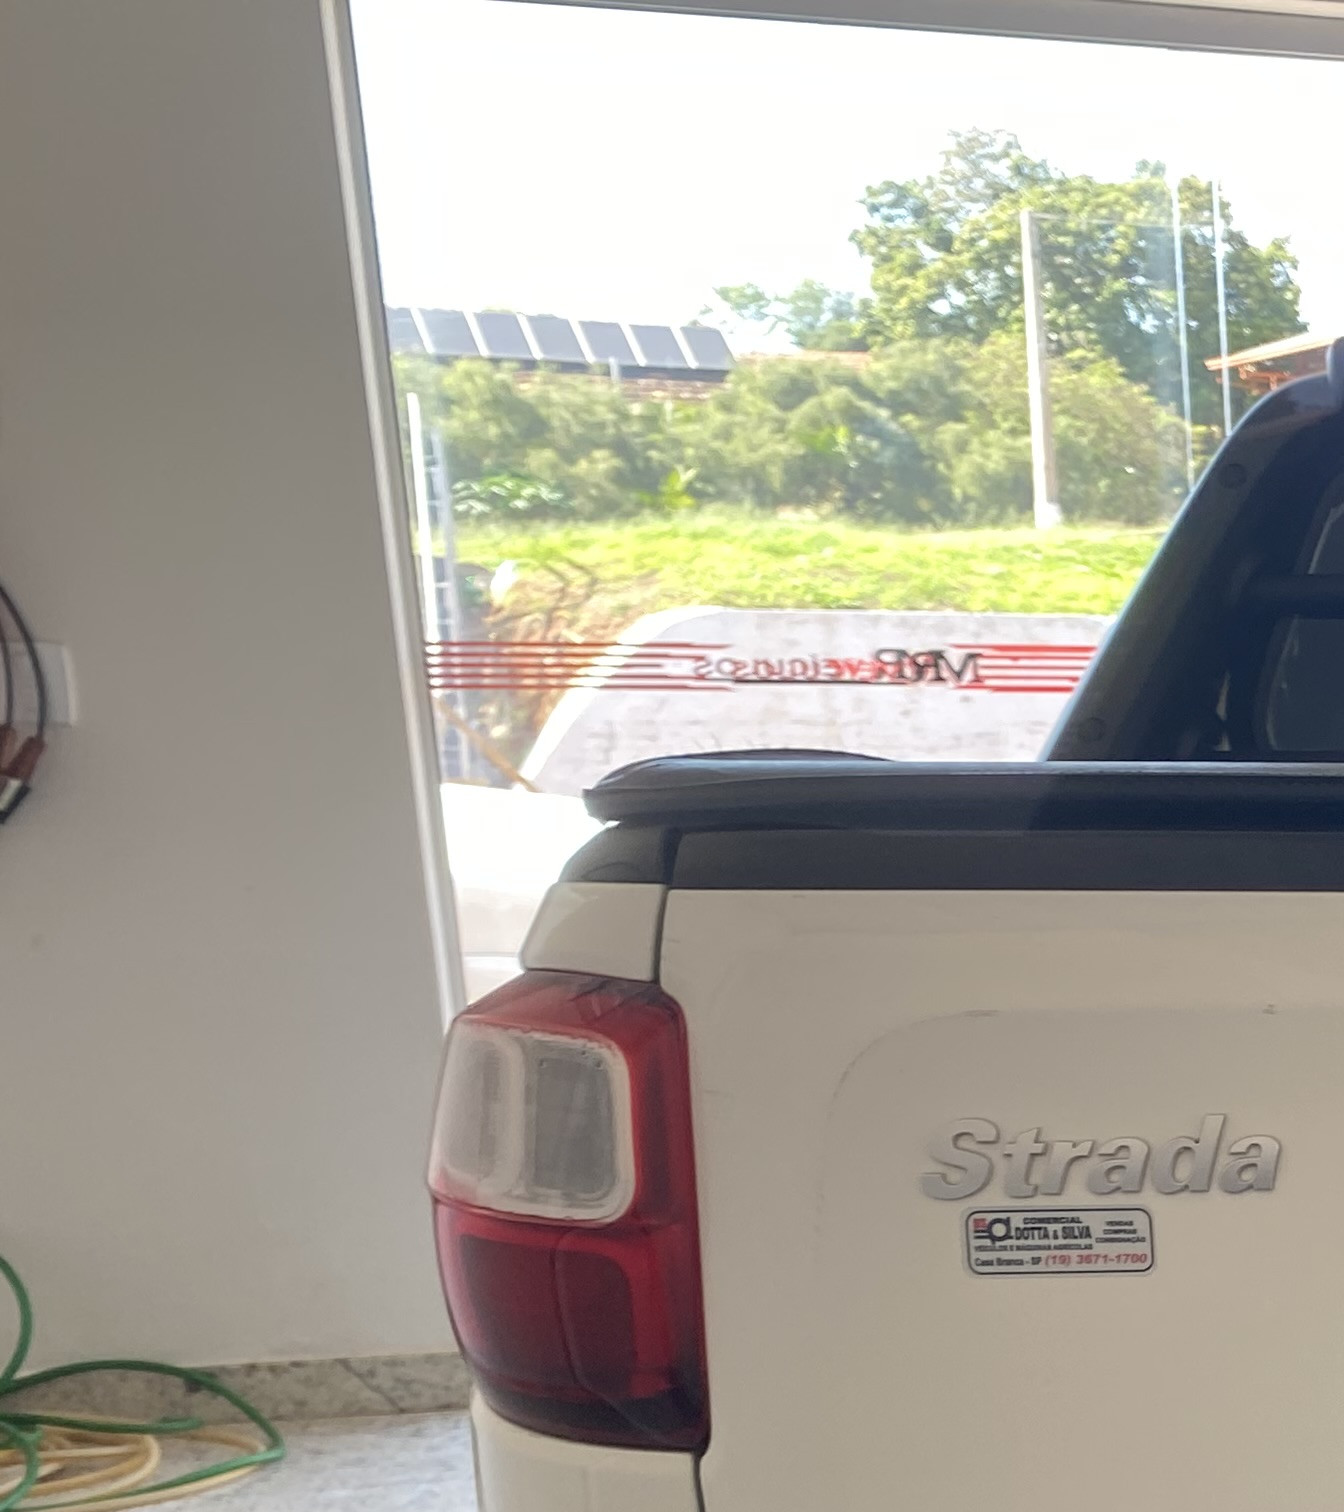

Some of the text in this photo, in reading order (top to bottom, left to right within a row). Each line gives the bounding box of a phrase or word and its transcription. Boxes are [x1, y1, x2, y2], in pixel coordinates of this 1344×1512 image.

[920, 1113, 1282, 1200] Strada
[1015, 1226, 1050, 1241] DOTTA
[1061, 1226, 1093, 1240] SILVA
